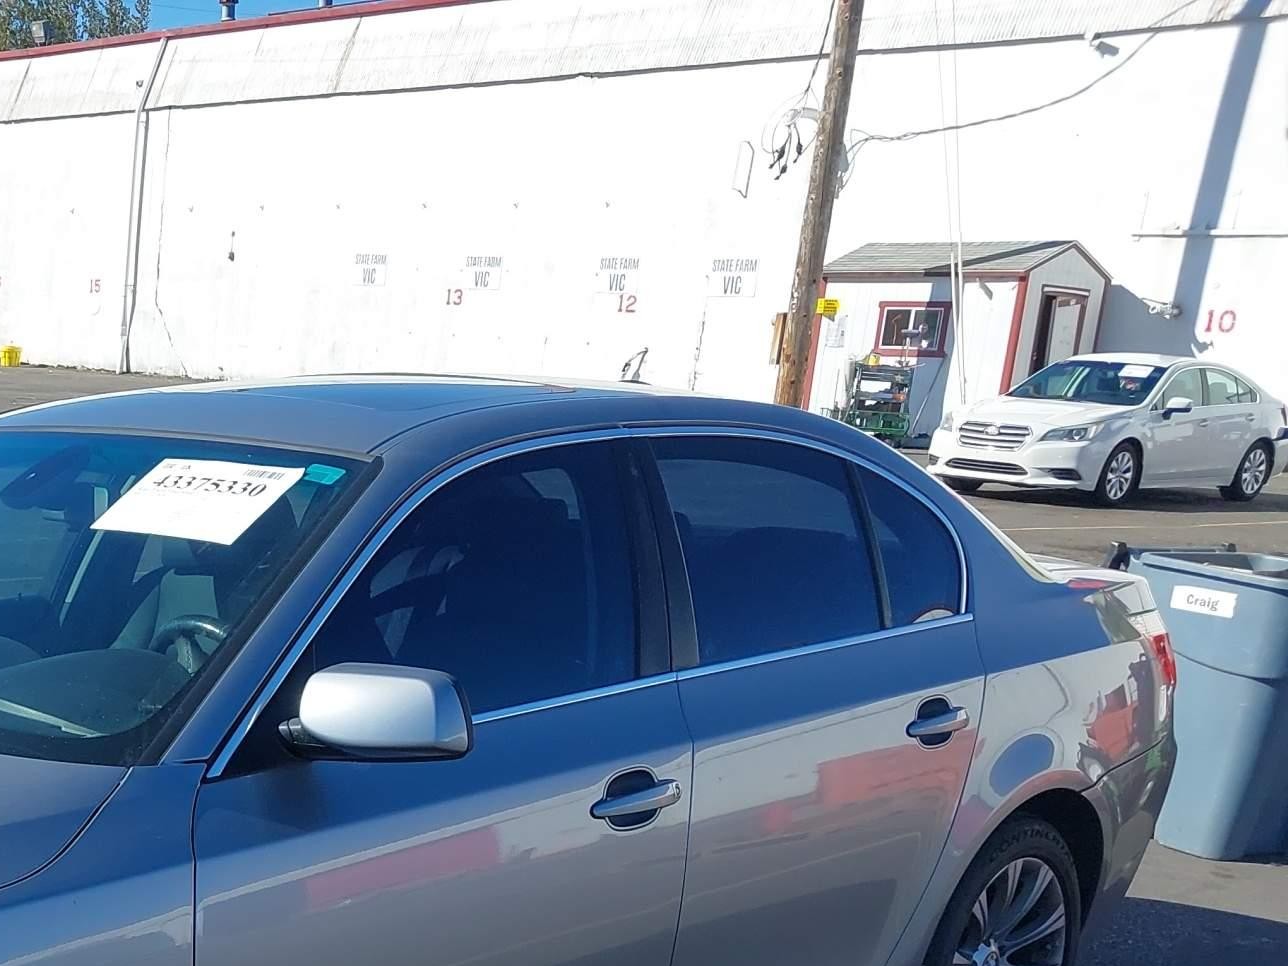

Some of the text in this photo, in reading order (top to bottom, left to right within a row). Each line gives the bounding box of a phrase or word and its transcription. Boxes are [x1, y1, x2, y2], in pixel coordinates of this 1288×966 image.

[355, 253, 387, 265] STATE FARM
[466, 255, 502, 268] STATE FARM
[599, 257, 640, 271] STATE FARM
[712, 258, 758, 273] STATE FARM
[362, 267, 376, 284] VIC
[474, 271, 490, 288] VIC
[608, 273, 626, 292] VIC
[89, 279, 101, 294] 15
[723, 275, 742, 294] VIC
[445, 288, 463, 306] 13
[617, 294, 637, 313] 12
[1204, 309, 1237, 333] 10
[153, 474, 267, 497] 43375330
[1186, 593, 1220, 612] Craig
